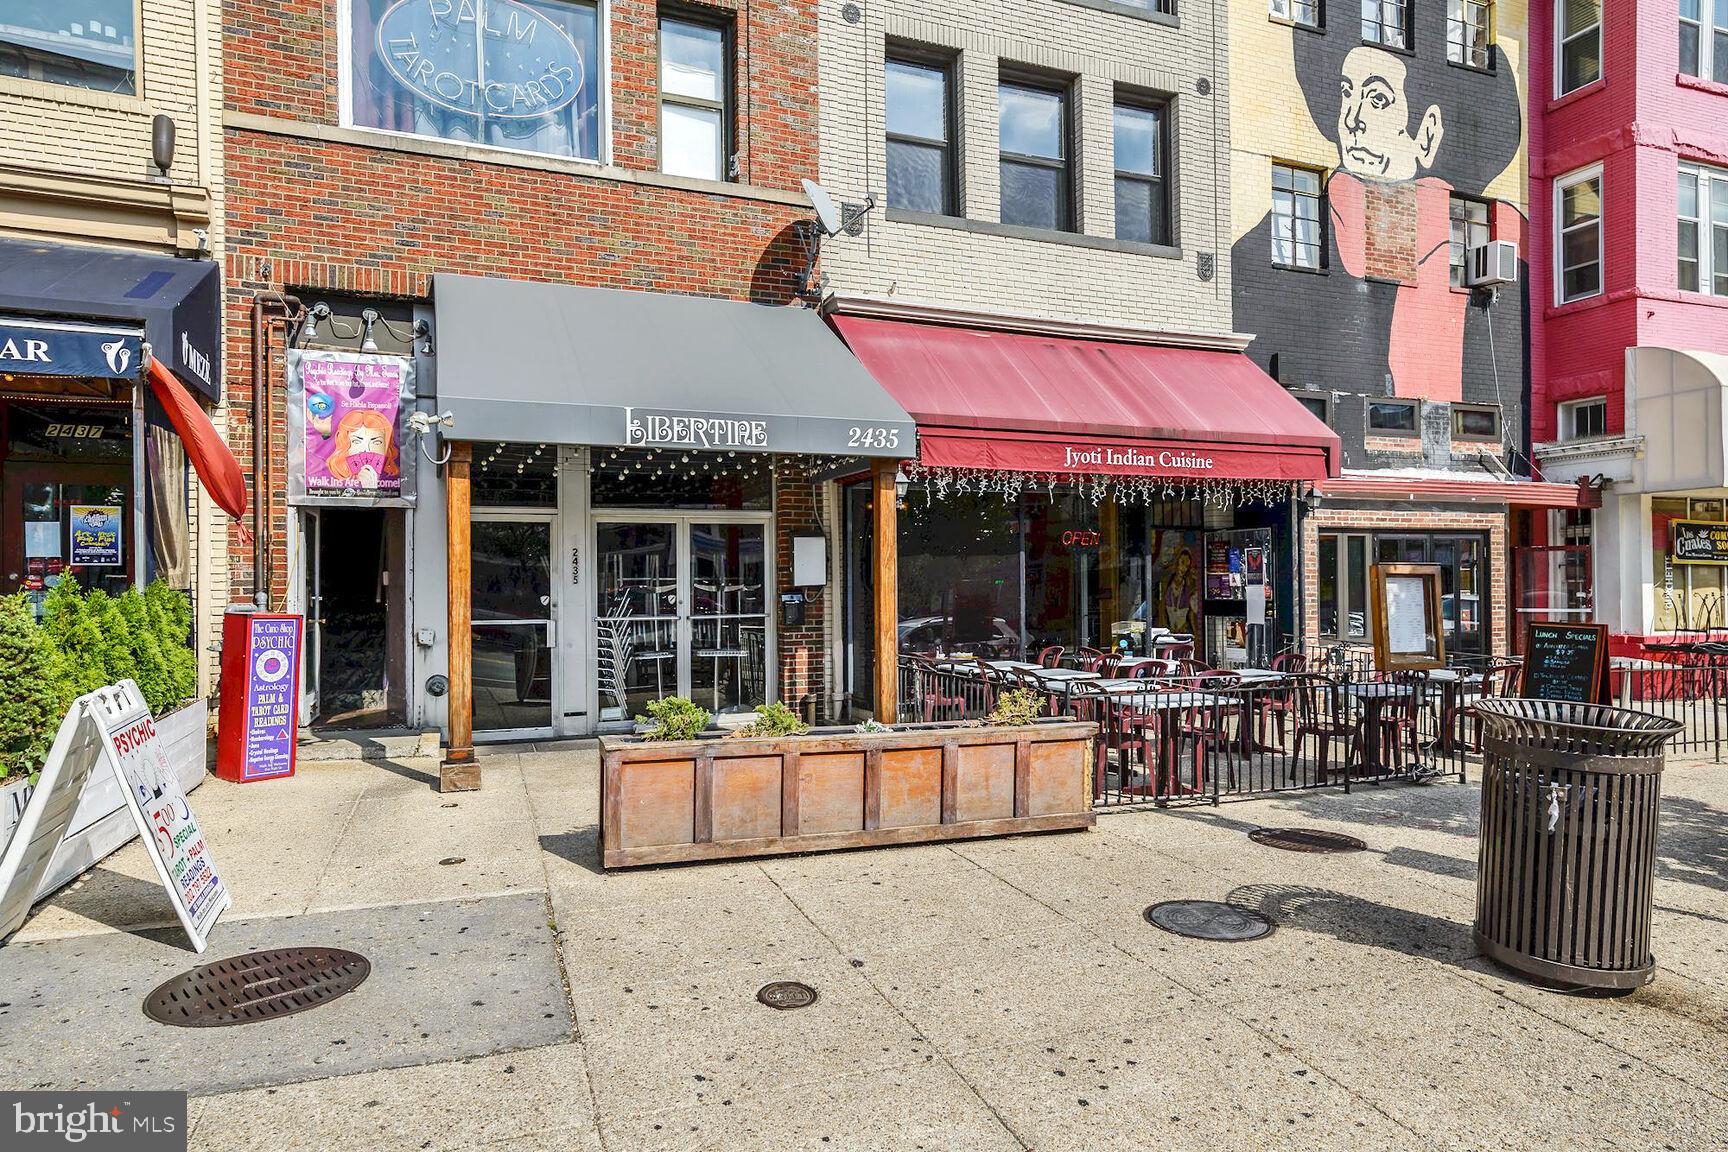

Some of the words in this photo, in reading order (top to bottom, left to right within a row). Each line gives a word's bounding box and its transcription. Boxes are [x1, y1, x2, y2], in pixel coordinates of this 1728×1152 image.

[430, 0, 537, 43] PALM
[389, 32, 479, 105] TAROT
[485, 60, 574, 112] CARDS
[46, 424, 104, 438] 2437
[624, 406, 768, 448] LIBERTINE
[848, 427, 900, 449] 2435
[1064, 446, 1102, 468] Jyoti
[1106, 448, 1156, 467] Indian
[1159, 451, 1214, 469] Cuisine
[1062, 530, 1100, 546] OPEN
[1677, 536, 1712, 556] Cuates
[254, 623, 264, 633] The
[280, 623, 293, 635] Shop
[252, 636, 295, 649] PSYCHIC
[253, 683, 289, 692] Astrology
[257, 693, 276, 704] PALM
[278, 692, 284, 703] &
[251, 705, 271, 717] TAROT
[272, 703, 289, 715] CARD
[253, 715, 286, 728] READINGS
[113, 718, 156, 758] PSYCHIC
[172, 822, 197, 849] SPECIAL
[188, 839, 205, 861] PALM
[180, 856, 206, 889] READINGS
